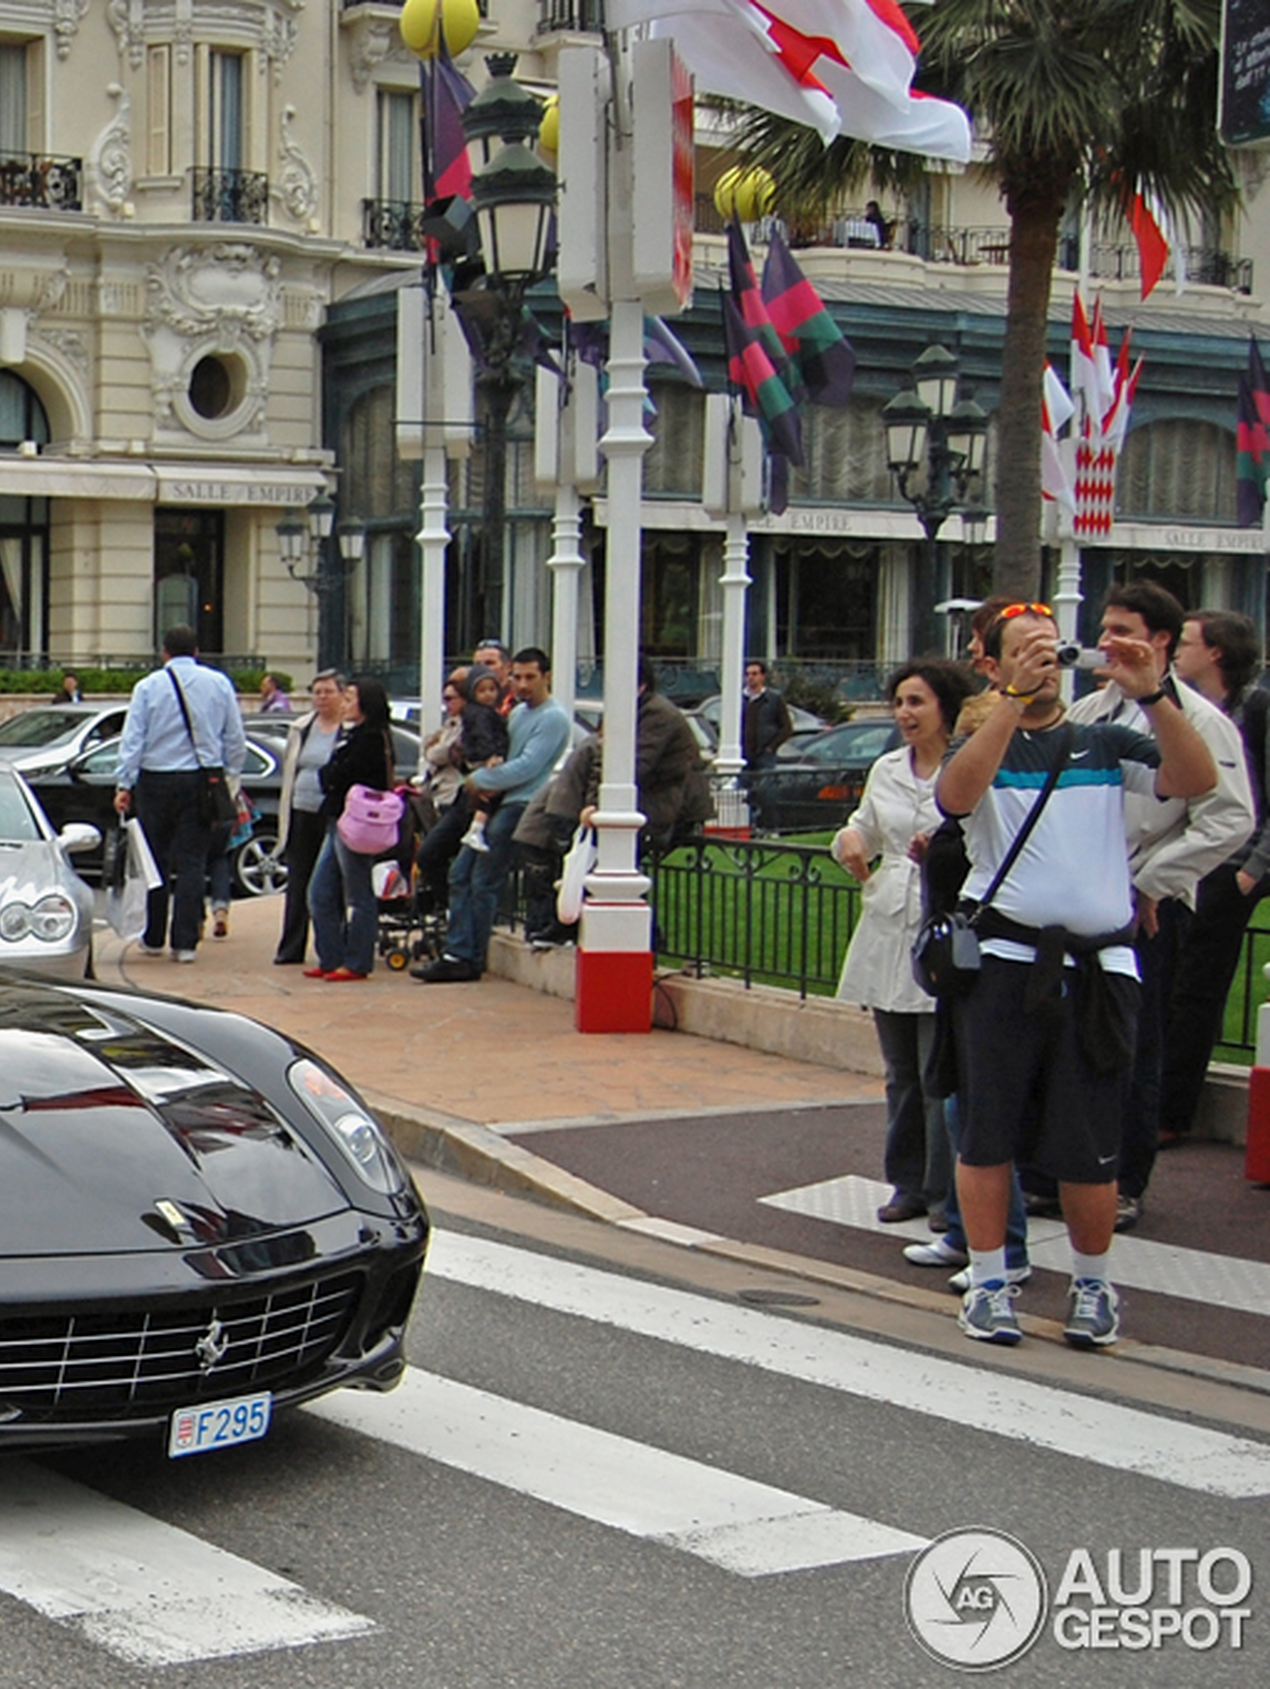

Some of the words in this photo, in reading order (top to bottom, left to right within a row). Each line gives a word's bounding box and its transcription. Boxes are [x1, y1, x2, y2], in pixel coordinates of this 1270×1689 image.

[173, 484, 230, 500] SALLE
[791, 514, 852, 532] EMPIRE
[196, 1401, 265, 1445] F295
